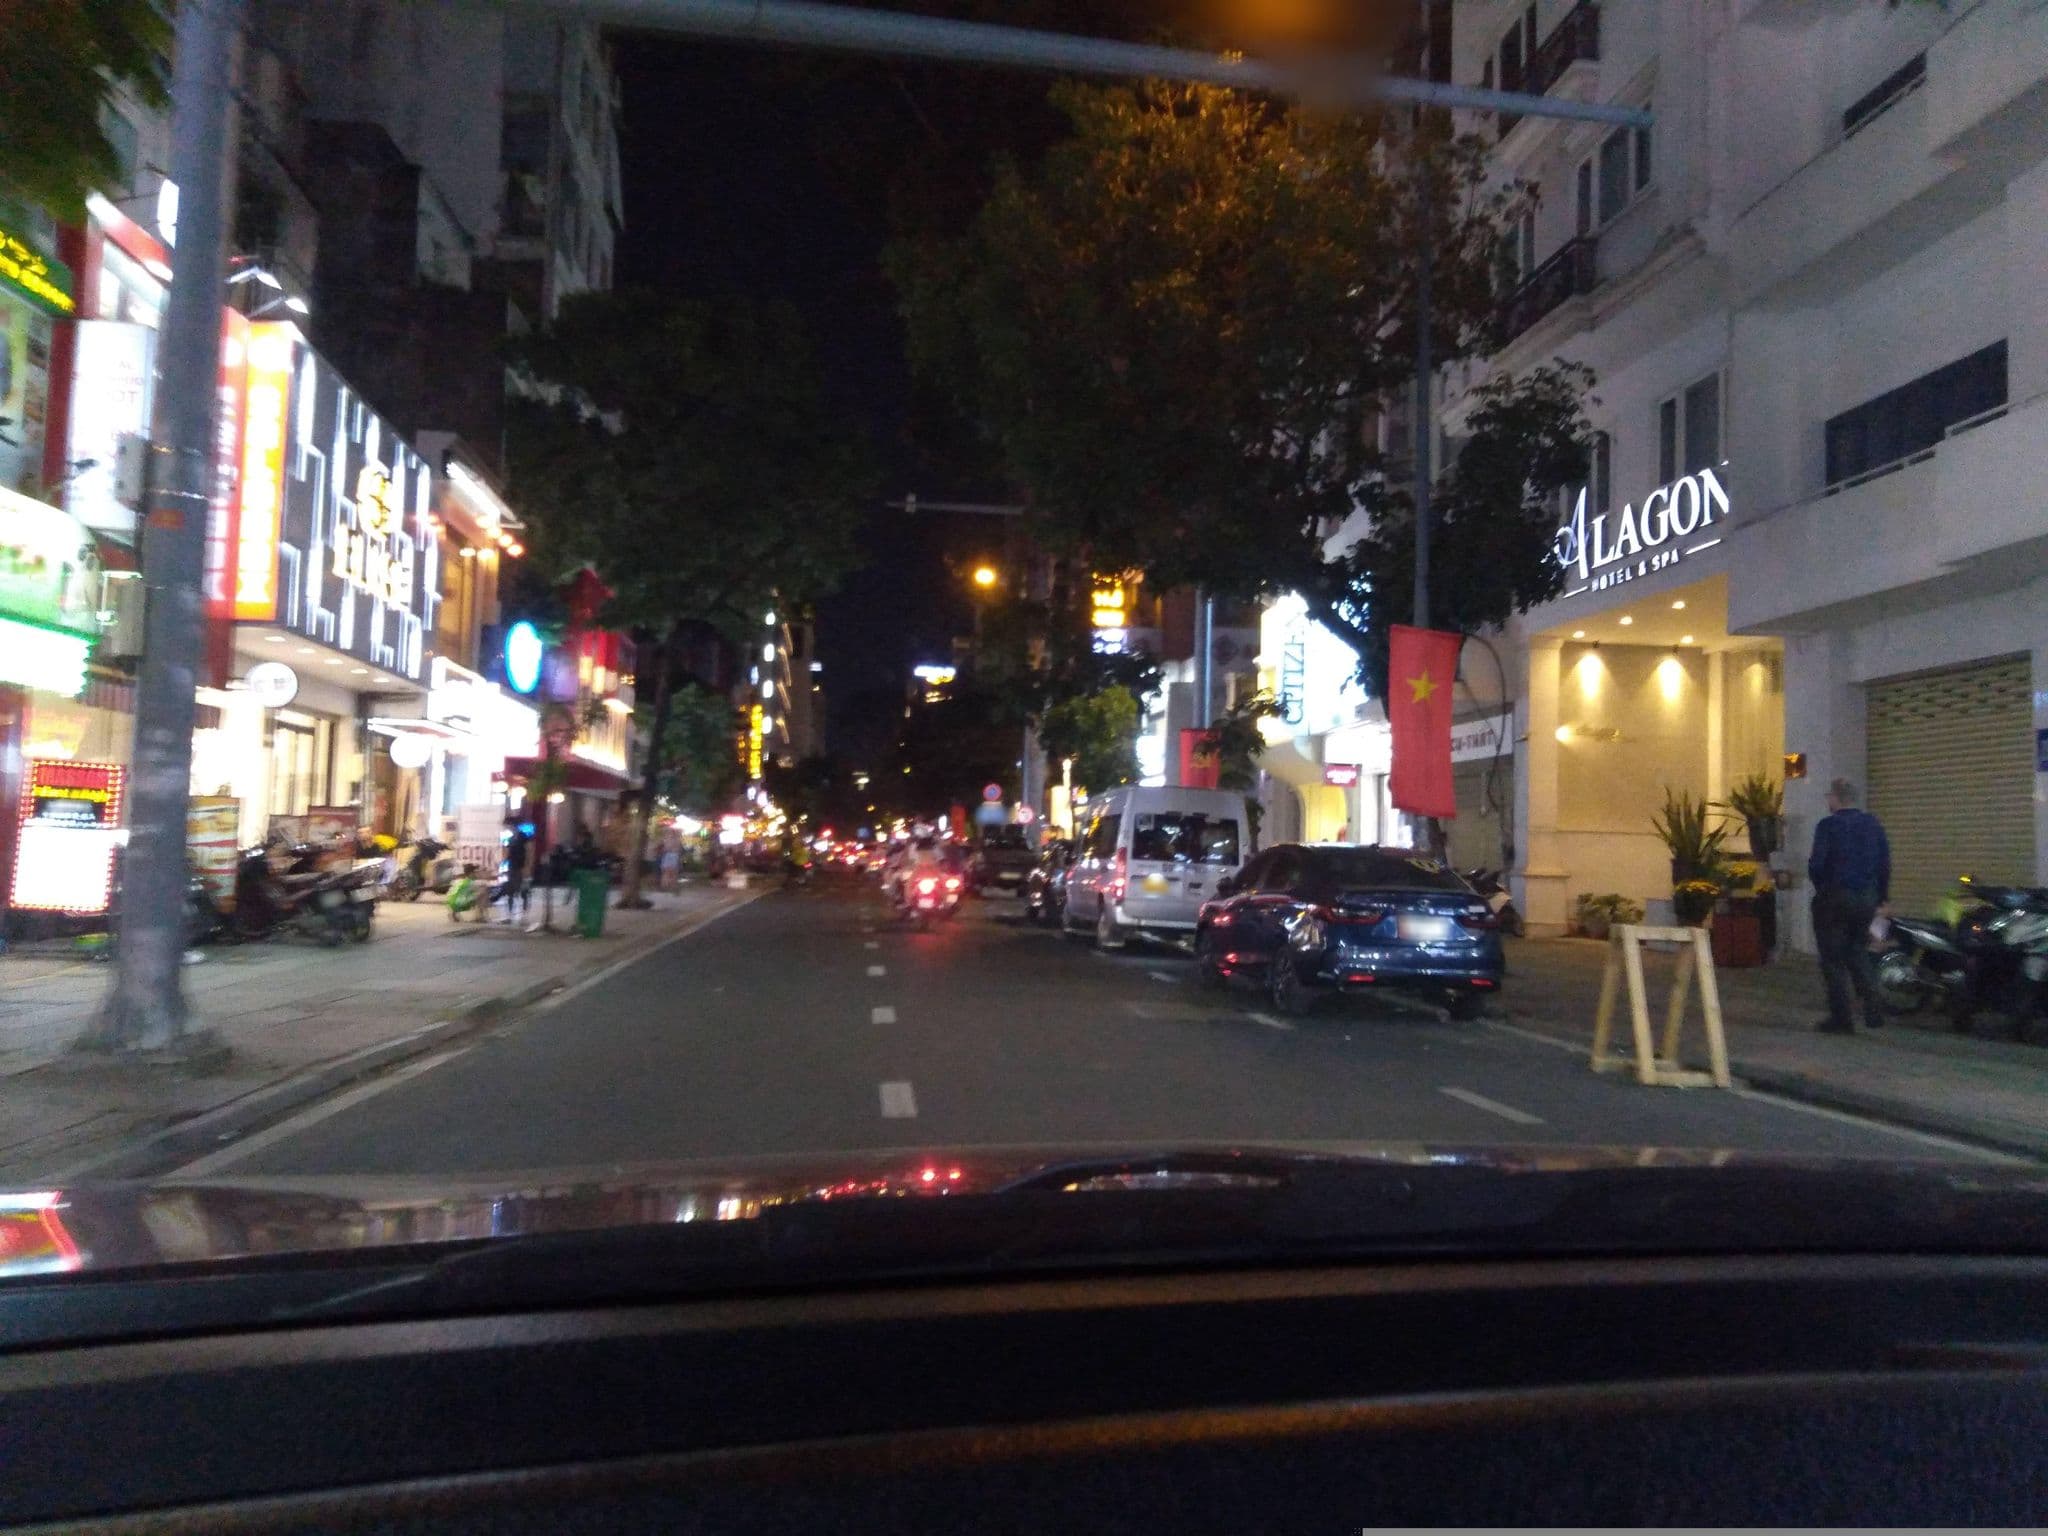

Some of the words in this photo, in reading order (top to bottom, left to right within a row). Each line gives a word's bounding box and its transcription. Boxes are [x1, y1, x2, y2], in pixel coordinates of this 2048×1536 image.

[1553, 462, 1730, 580] ALAGON
[1591, 567, 1633, 593] HOTEL
[1638, 560, 1647, 577] &
[1651, 548, 1679, 573] SPA
